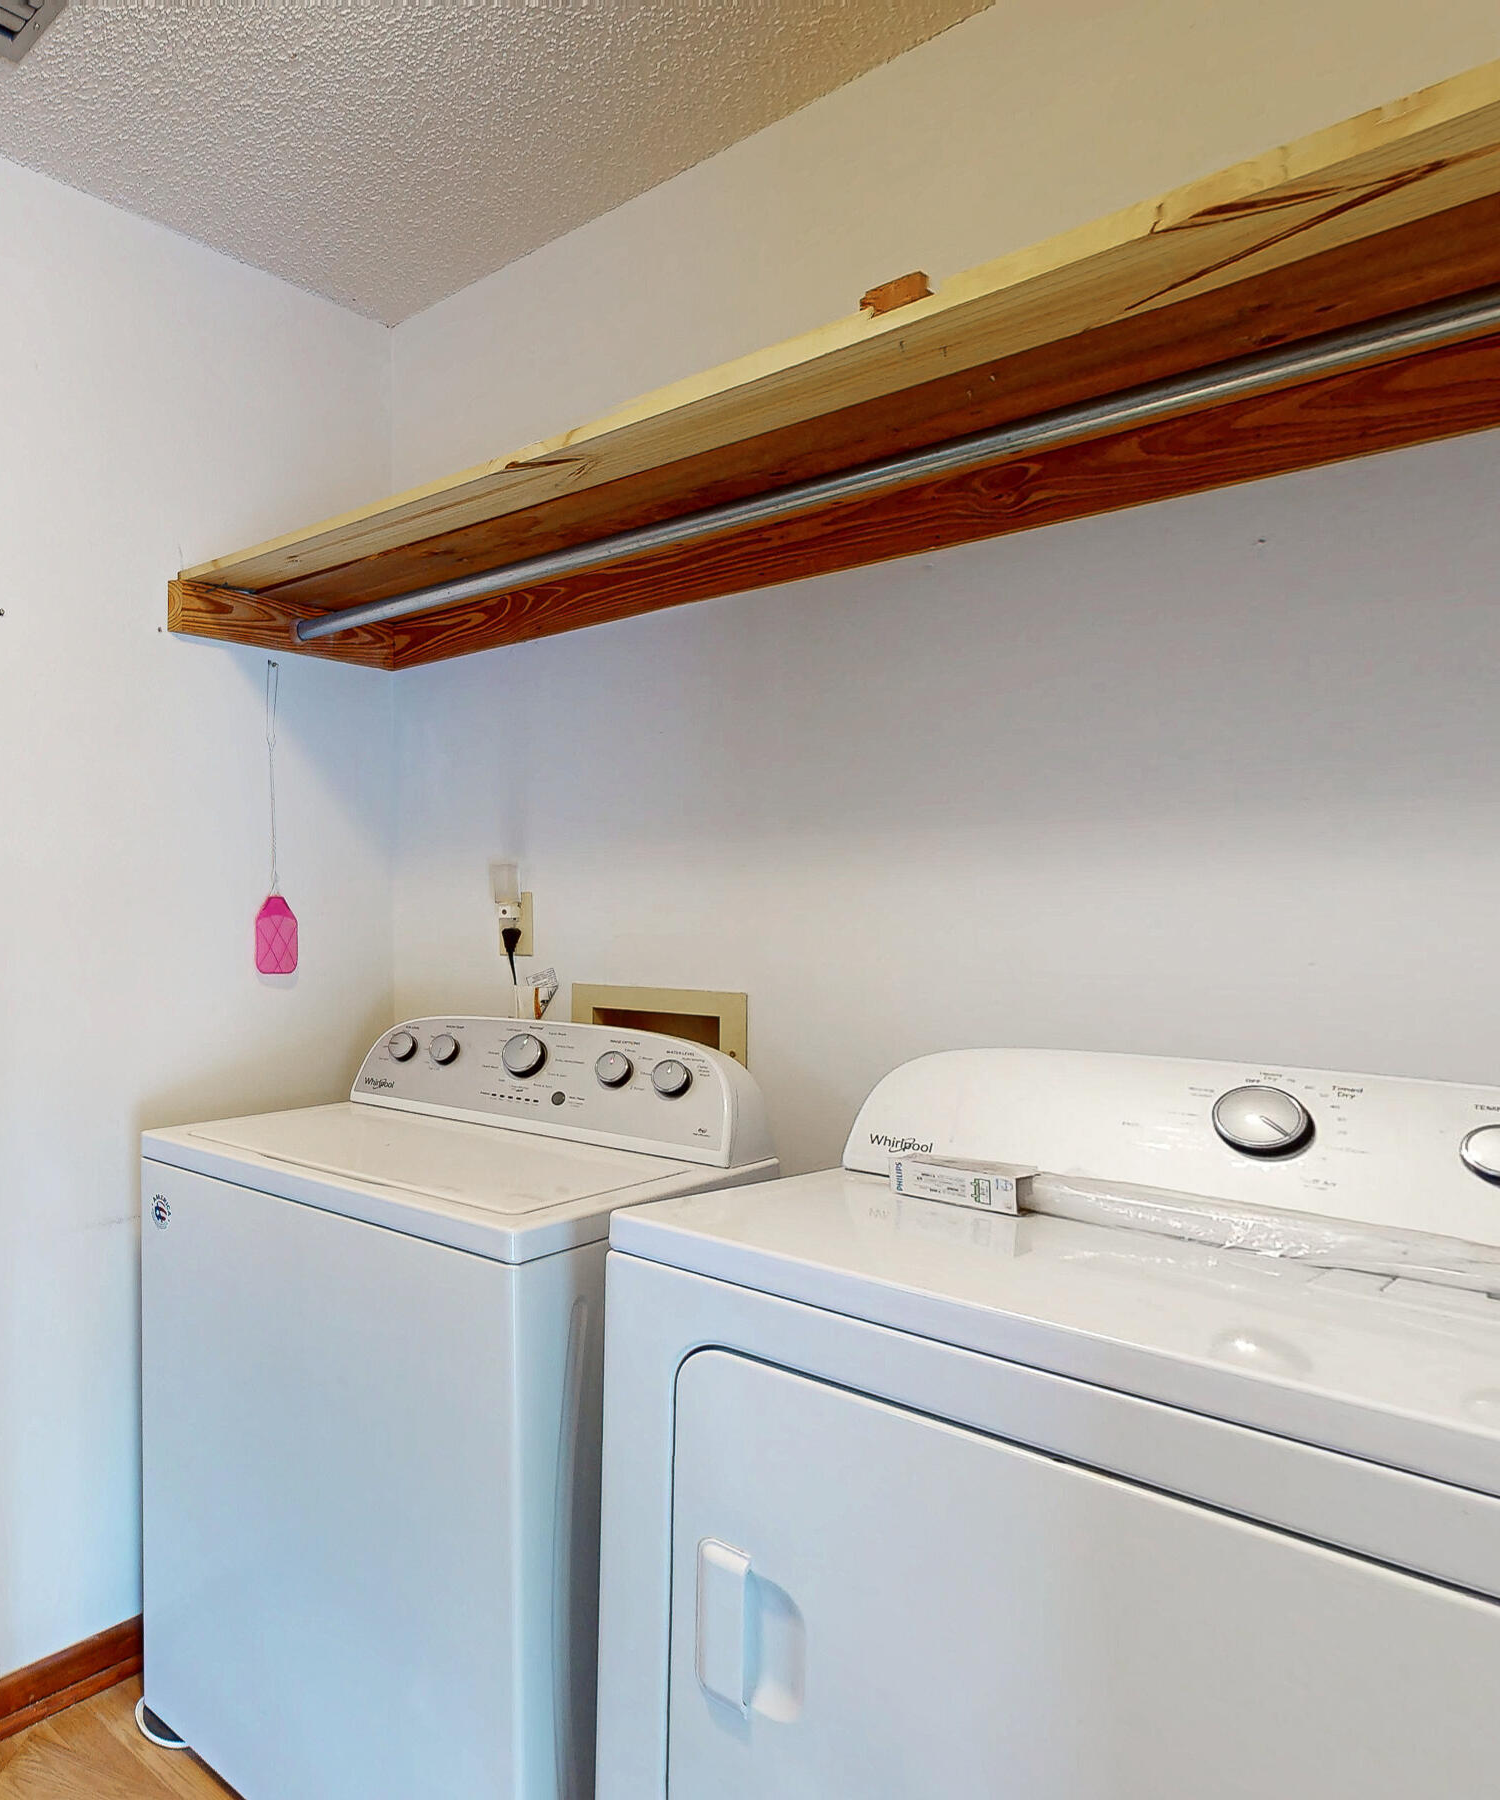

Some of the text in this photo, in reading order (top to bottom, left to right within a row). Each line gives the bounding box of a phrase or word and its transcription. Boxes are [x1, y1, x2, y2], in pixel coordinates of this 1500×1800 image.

[364, 1076, 395, 1089] Whirlpool
[869, 1133, 933, 1153] Whirlpool
[894, 1161, 903, 1192] PHILIPS
